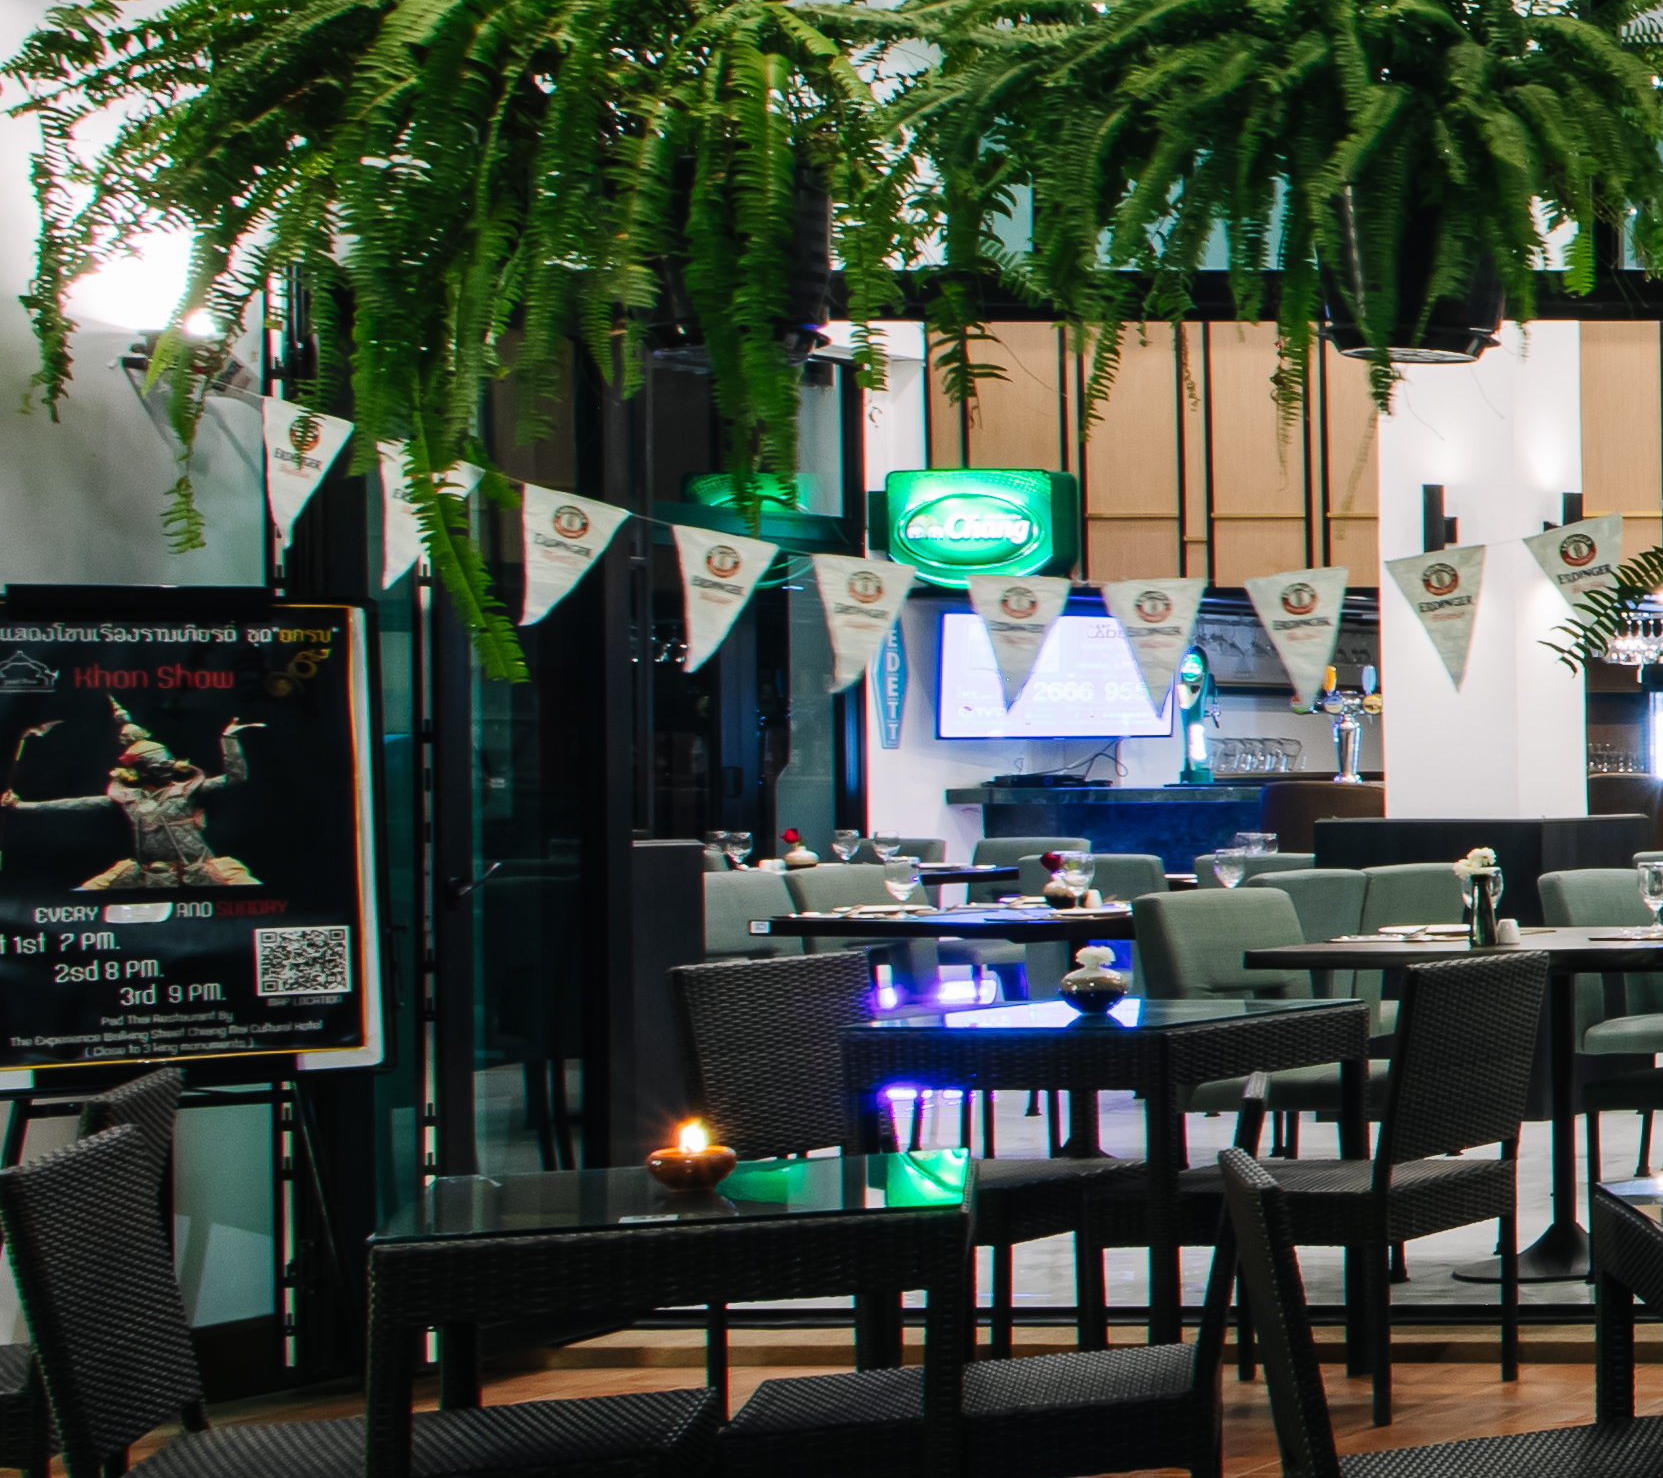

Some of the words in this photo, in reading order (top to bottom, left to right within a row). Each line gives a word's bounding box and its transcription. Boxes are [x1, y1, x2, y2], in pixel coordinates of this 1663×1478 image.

[944, 513, 1031, 545] Chang
[74, 663, 149, 689] Khon
[157, 663, 235, 689] Show
[886, 629, 901, 740] EDETT
[34, 906, 99, 924] EVERY
[176, 902, 213, 919] AND
[214, 900, 288, 920] SUNDAY
[13, 932, 47, 954] 1st
[59, 933, 75, 952] 7
[54, 959, 99, 984] 2sd
[104, 961, 120, 981] 8
[119, 983, 157, 1006] 3rd
[167, 984, 183, 1004] 9
